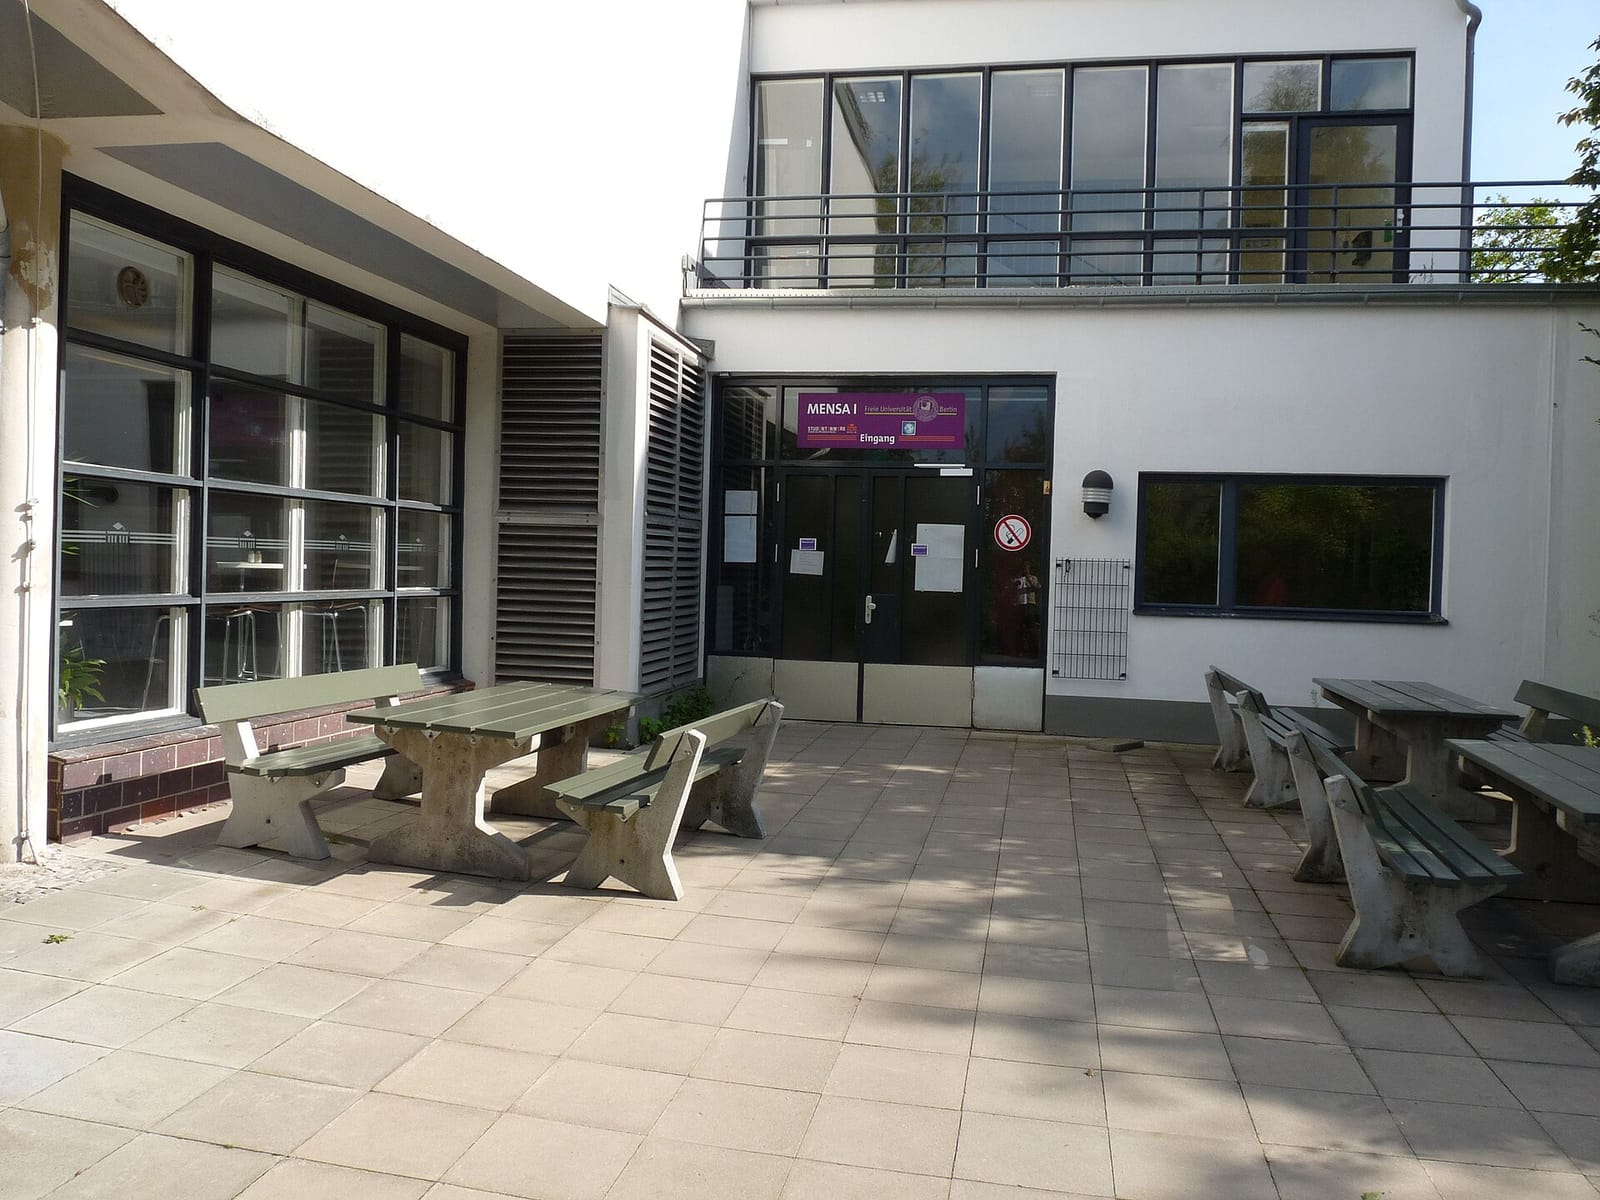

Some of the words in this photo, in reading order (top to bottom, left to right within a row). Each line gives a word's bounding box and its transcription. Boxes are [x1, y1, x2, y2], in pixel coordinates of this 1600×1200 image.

[807, 403, 850, 415] MENSA
[853, 404, 857, 415] I
[860, 433, 895, 444] Eingang
